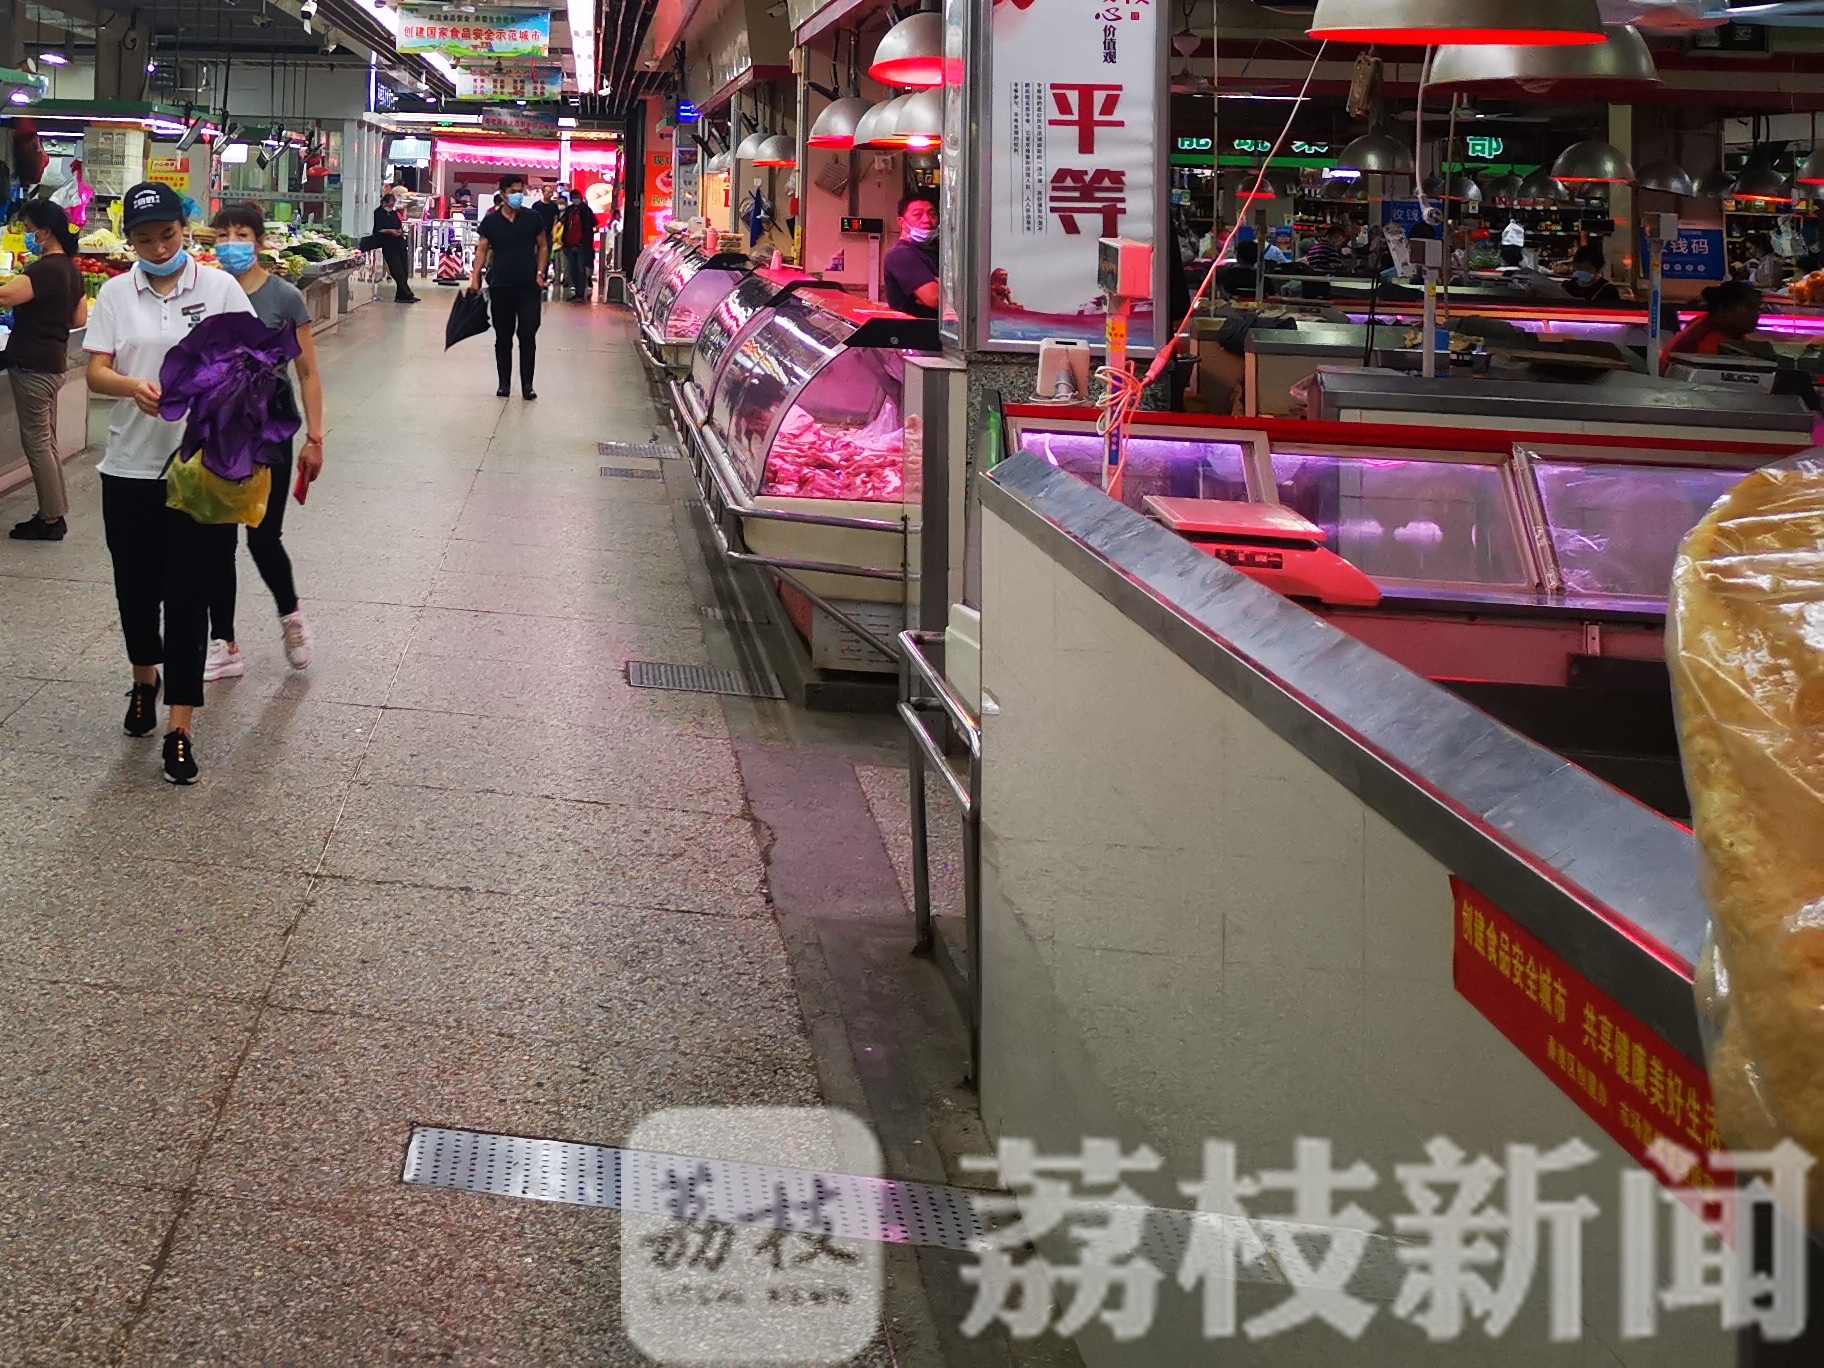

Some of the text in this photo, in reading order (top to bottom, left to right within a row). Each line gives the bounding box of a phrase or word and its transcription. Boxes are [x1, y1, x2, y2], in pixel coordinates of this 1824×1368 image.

[404, 26, 542, 43] 创建国家食品安全示范城市
[1048, 83, 1126, 238] 平等
